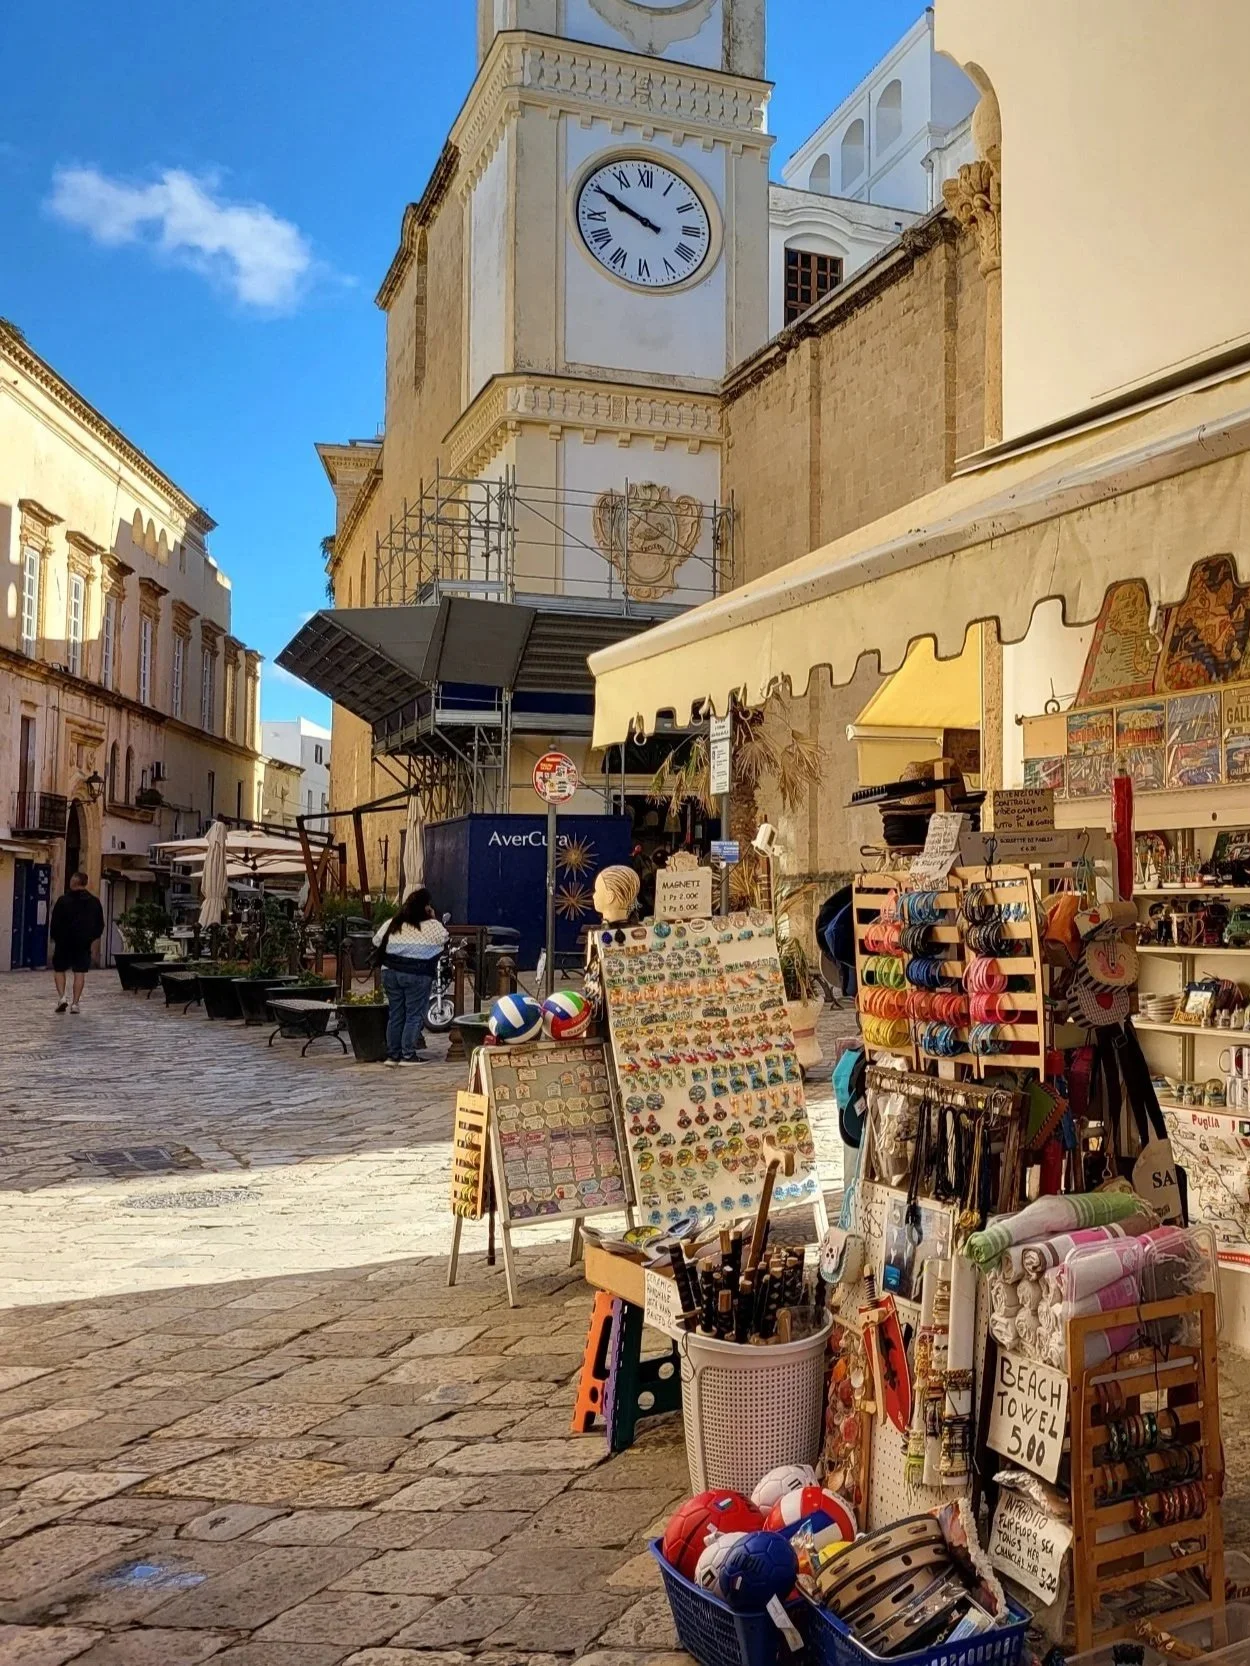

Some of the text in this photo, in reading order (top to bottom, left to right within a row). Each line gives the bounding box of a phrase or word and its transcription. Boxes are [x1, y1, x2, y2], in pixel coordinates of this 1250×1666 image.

[488, 831, 568, 847] AverCua
[662, 880, 701, 889] MAGNETI
[1192, 1114, 1220, 1129] Puglia
[1000, 1355, 1062, 1412] BEACH
[997, 1391, 1058, 1440] TOWEL
[1007, 1425, 1046, 1467] 5.00
[1041, 1538, 1055, 1558] SEA
